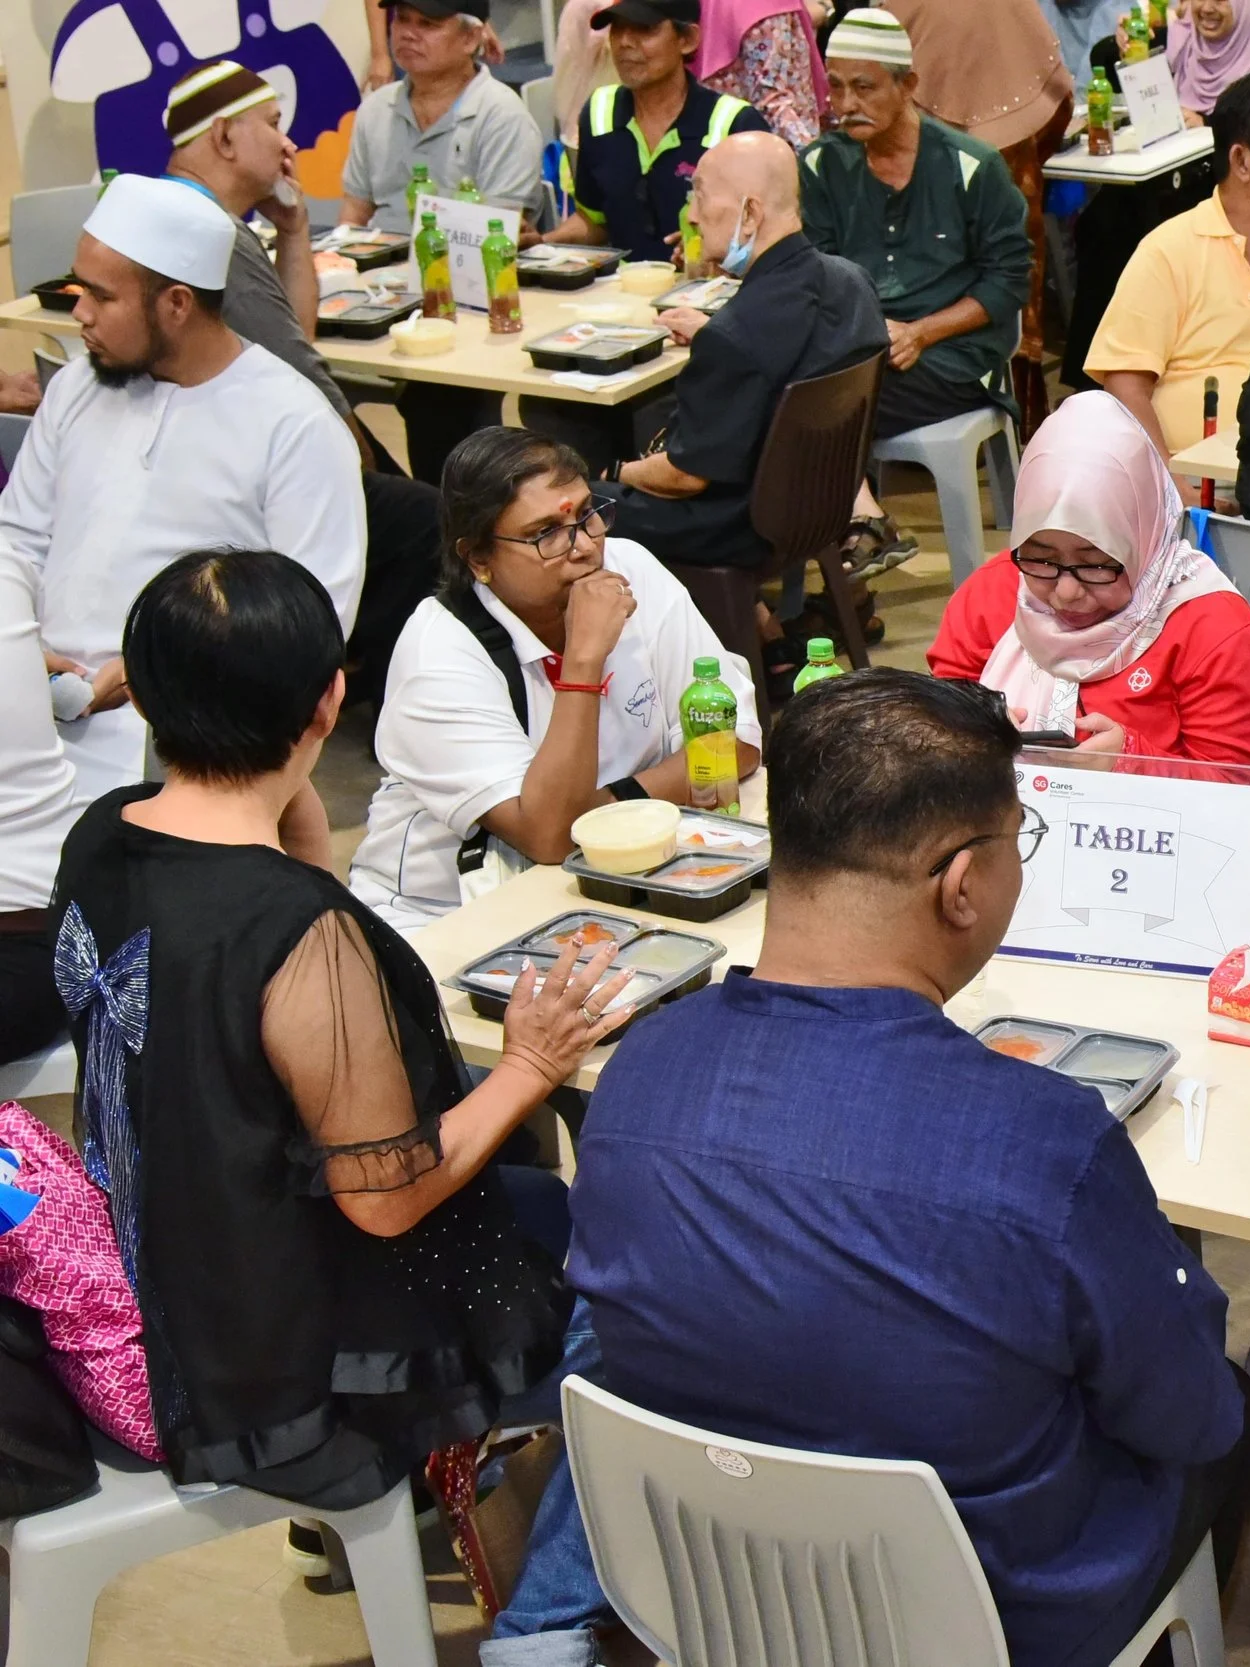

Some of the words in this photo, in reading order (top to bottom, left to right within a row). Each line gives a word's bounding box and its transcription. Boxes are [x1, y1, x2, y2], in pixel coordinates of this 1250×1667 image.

[456, 254, 464, 267] 6
[1034, 779, 1046, 788] SG
[1049, 781, 1073, 791] Cares
[1069, 822, 1176, 857] TABLE
[1110, 868, 1128, 894] 2
[1074, 953, 1082, 962] To
[1083, 955, 1099, 964] Serve
[1100, 957, 1112, 965] with
[1113, 959, 1126, 967] Love
[1139, 962, 1153, 970] Care
